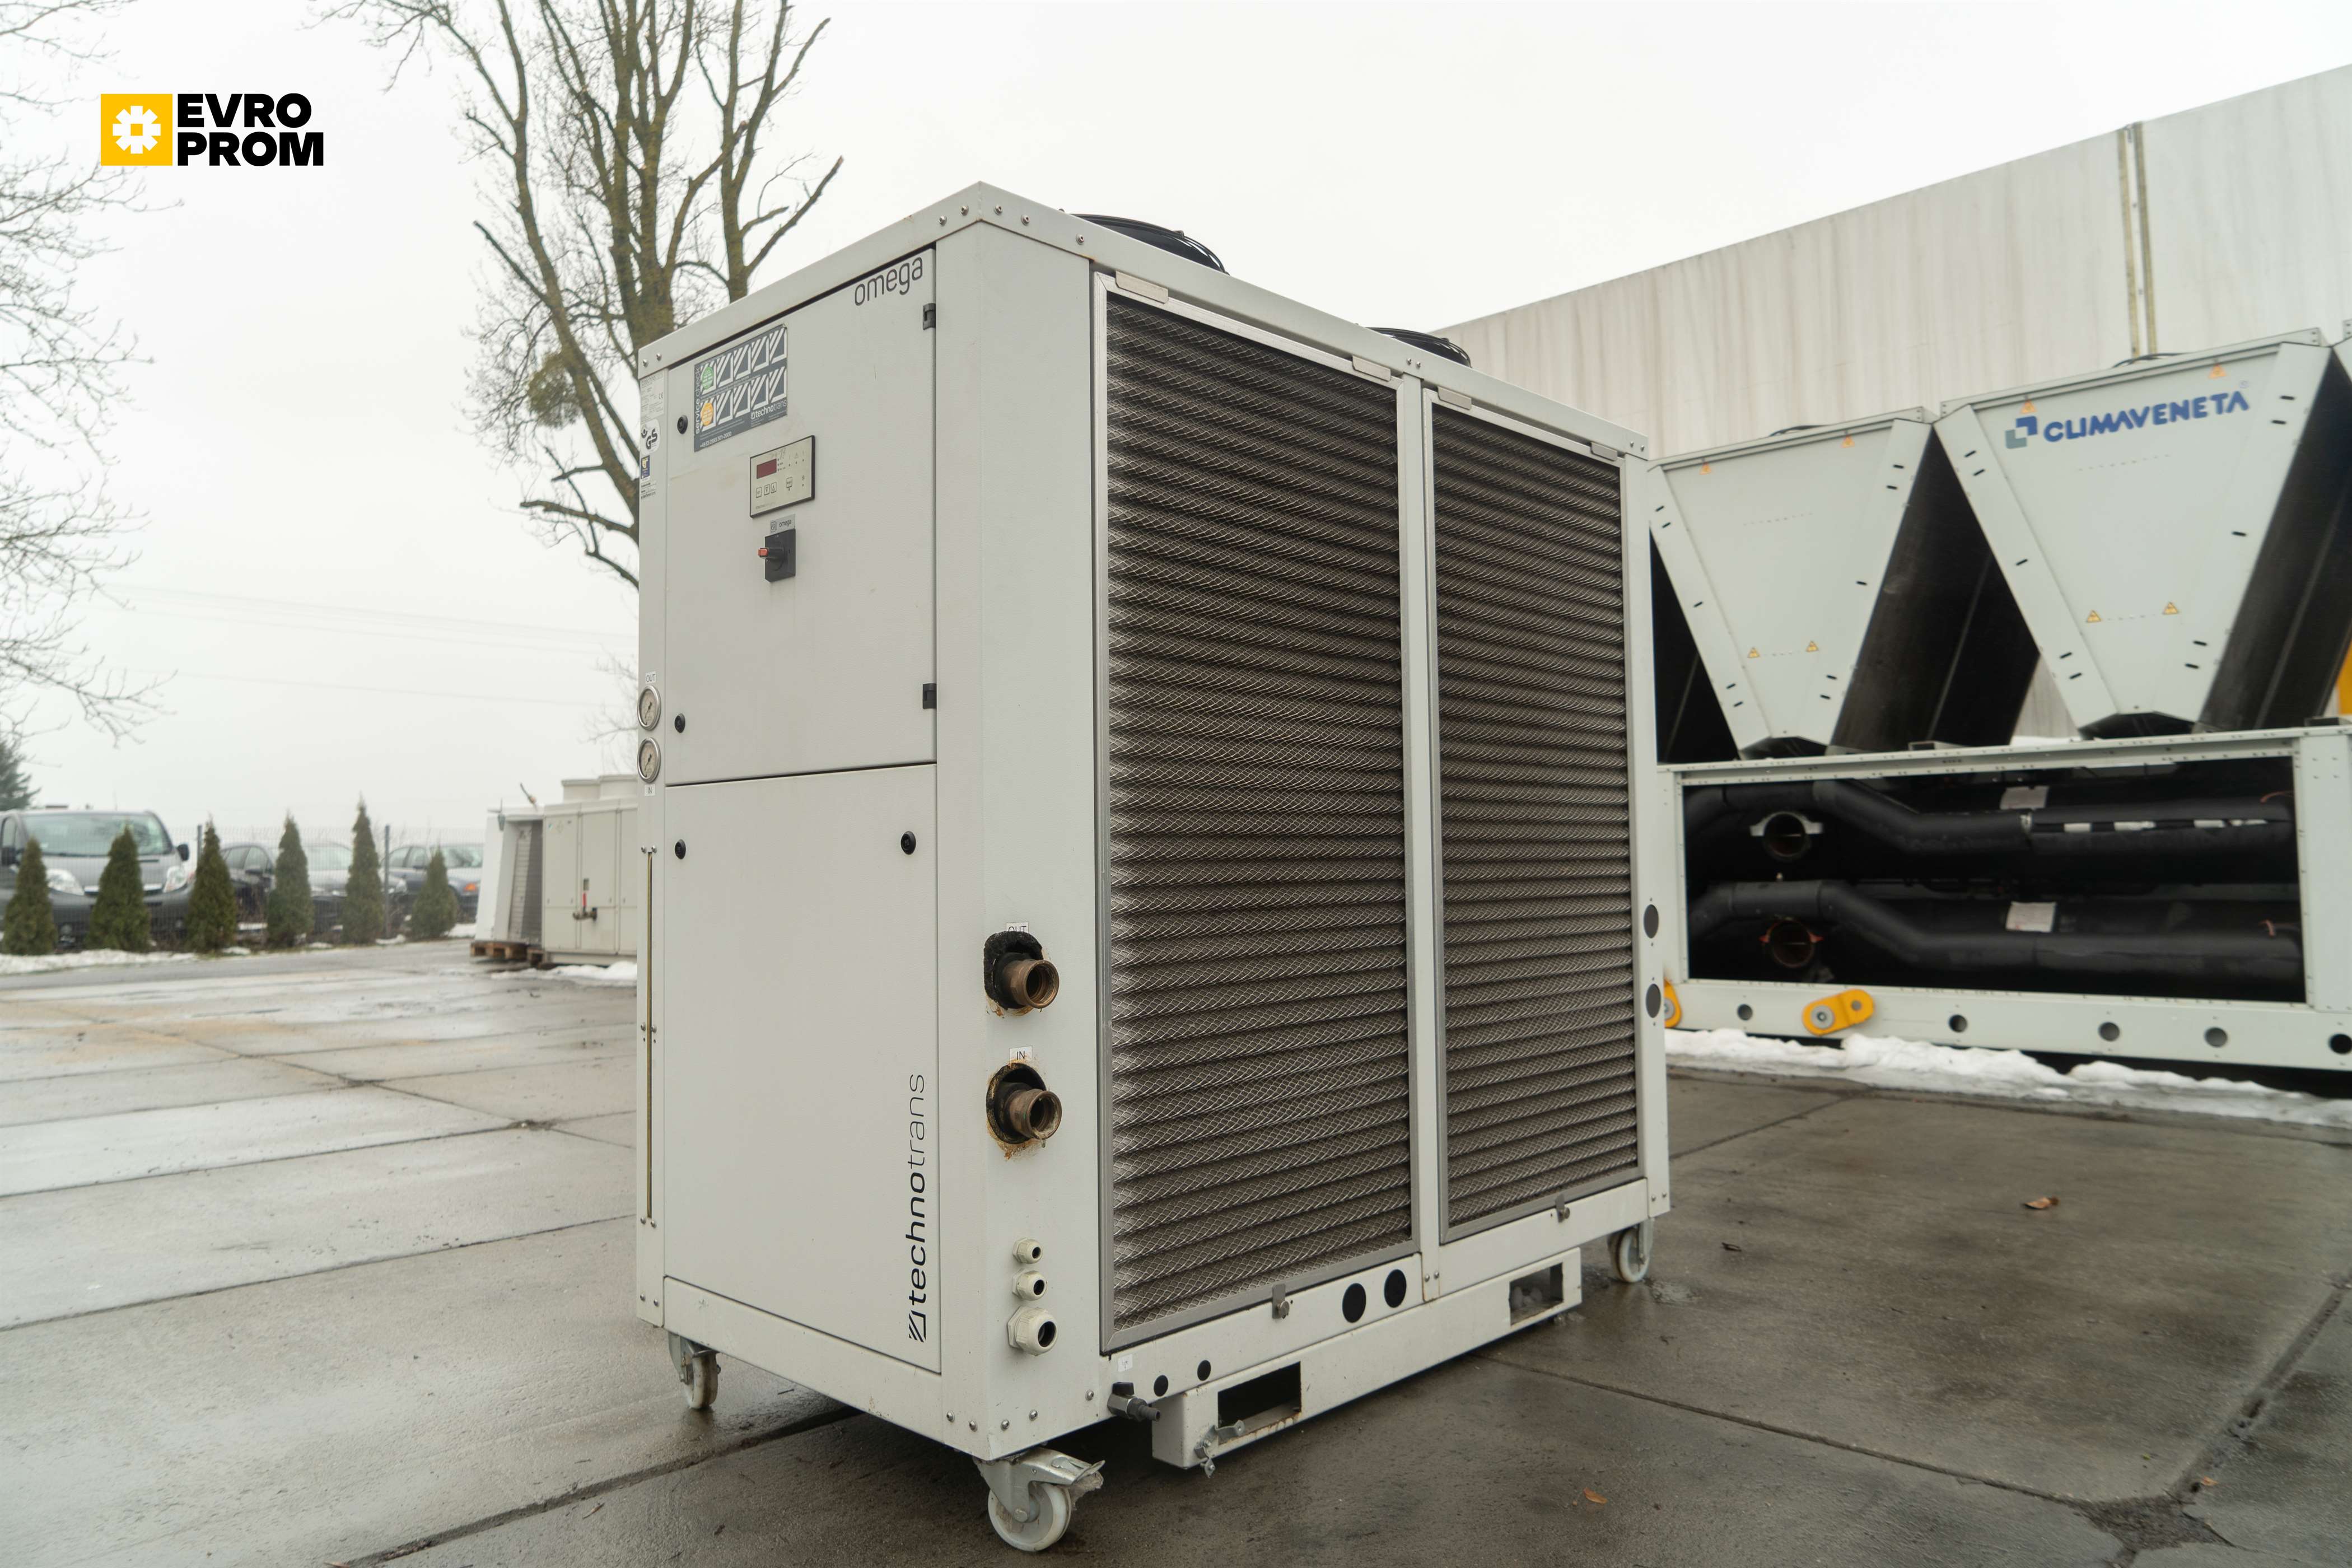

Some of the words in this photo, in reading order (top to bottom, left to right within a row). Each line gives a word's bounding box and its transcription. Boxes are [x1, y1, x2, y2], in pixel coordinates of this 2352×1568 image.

[855, 256, 923, 306] omega
[755, 399, 787, 418] technotrans
[2043, 390, 2250, 442] CLIMAVENETA
[646, 674, 656, 682] OUT
[1017, 1051, 1025, 1060] IN
[905, 1074, 927, 1306] technotrans
